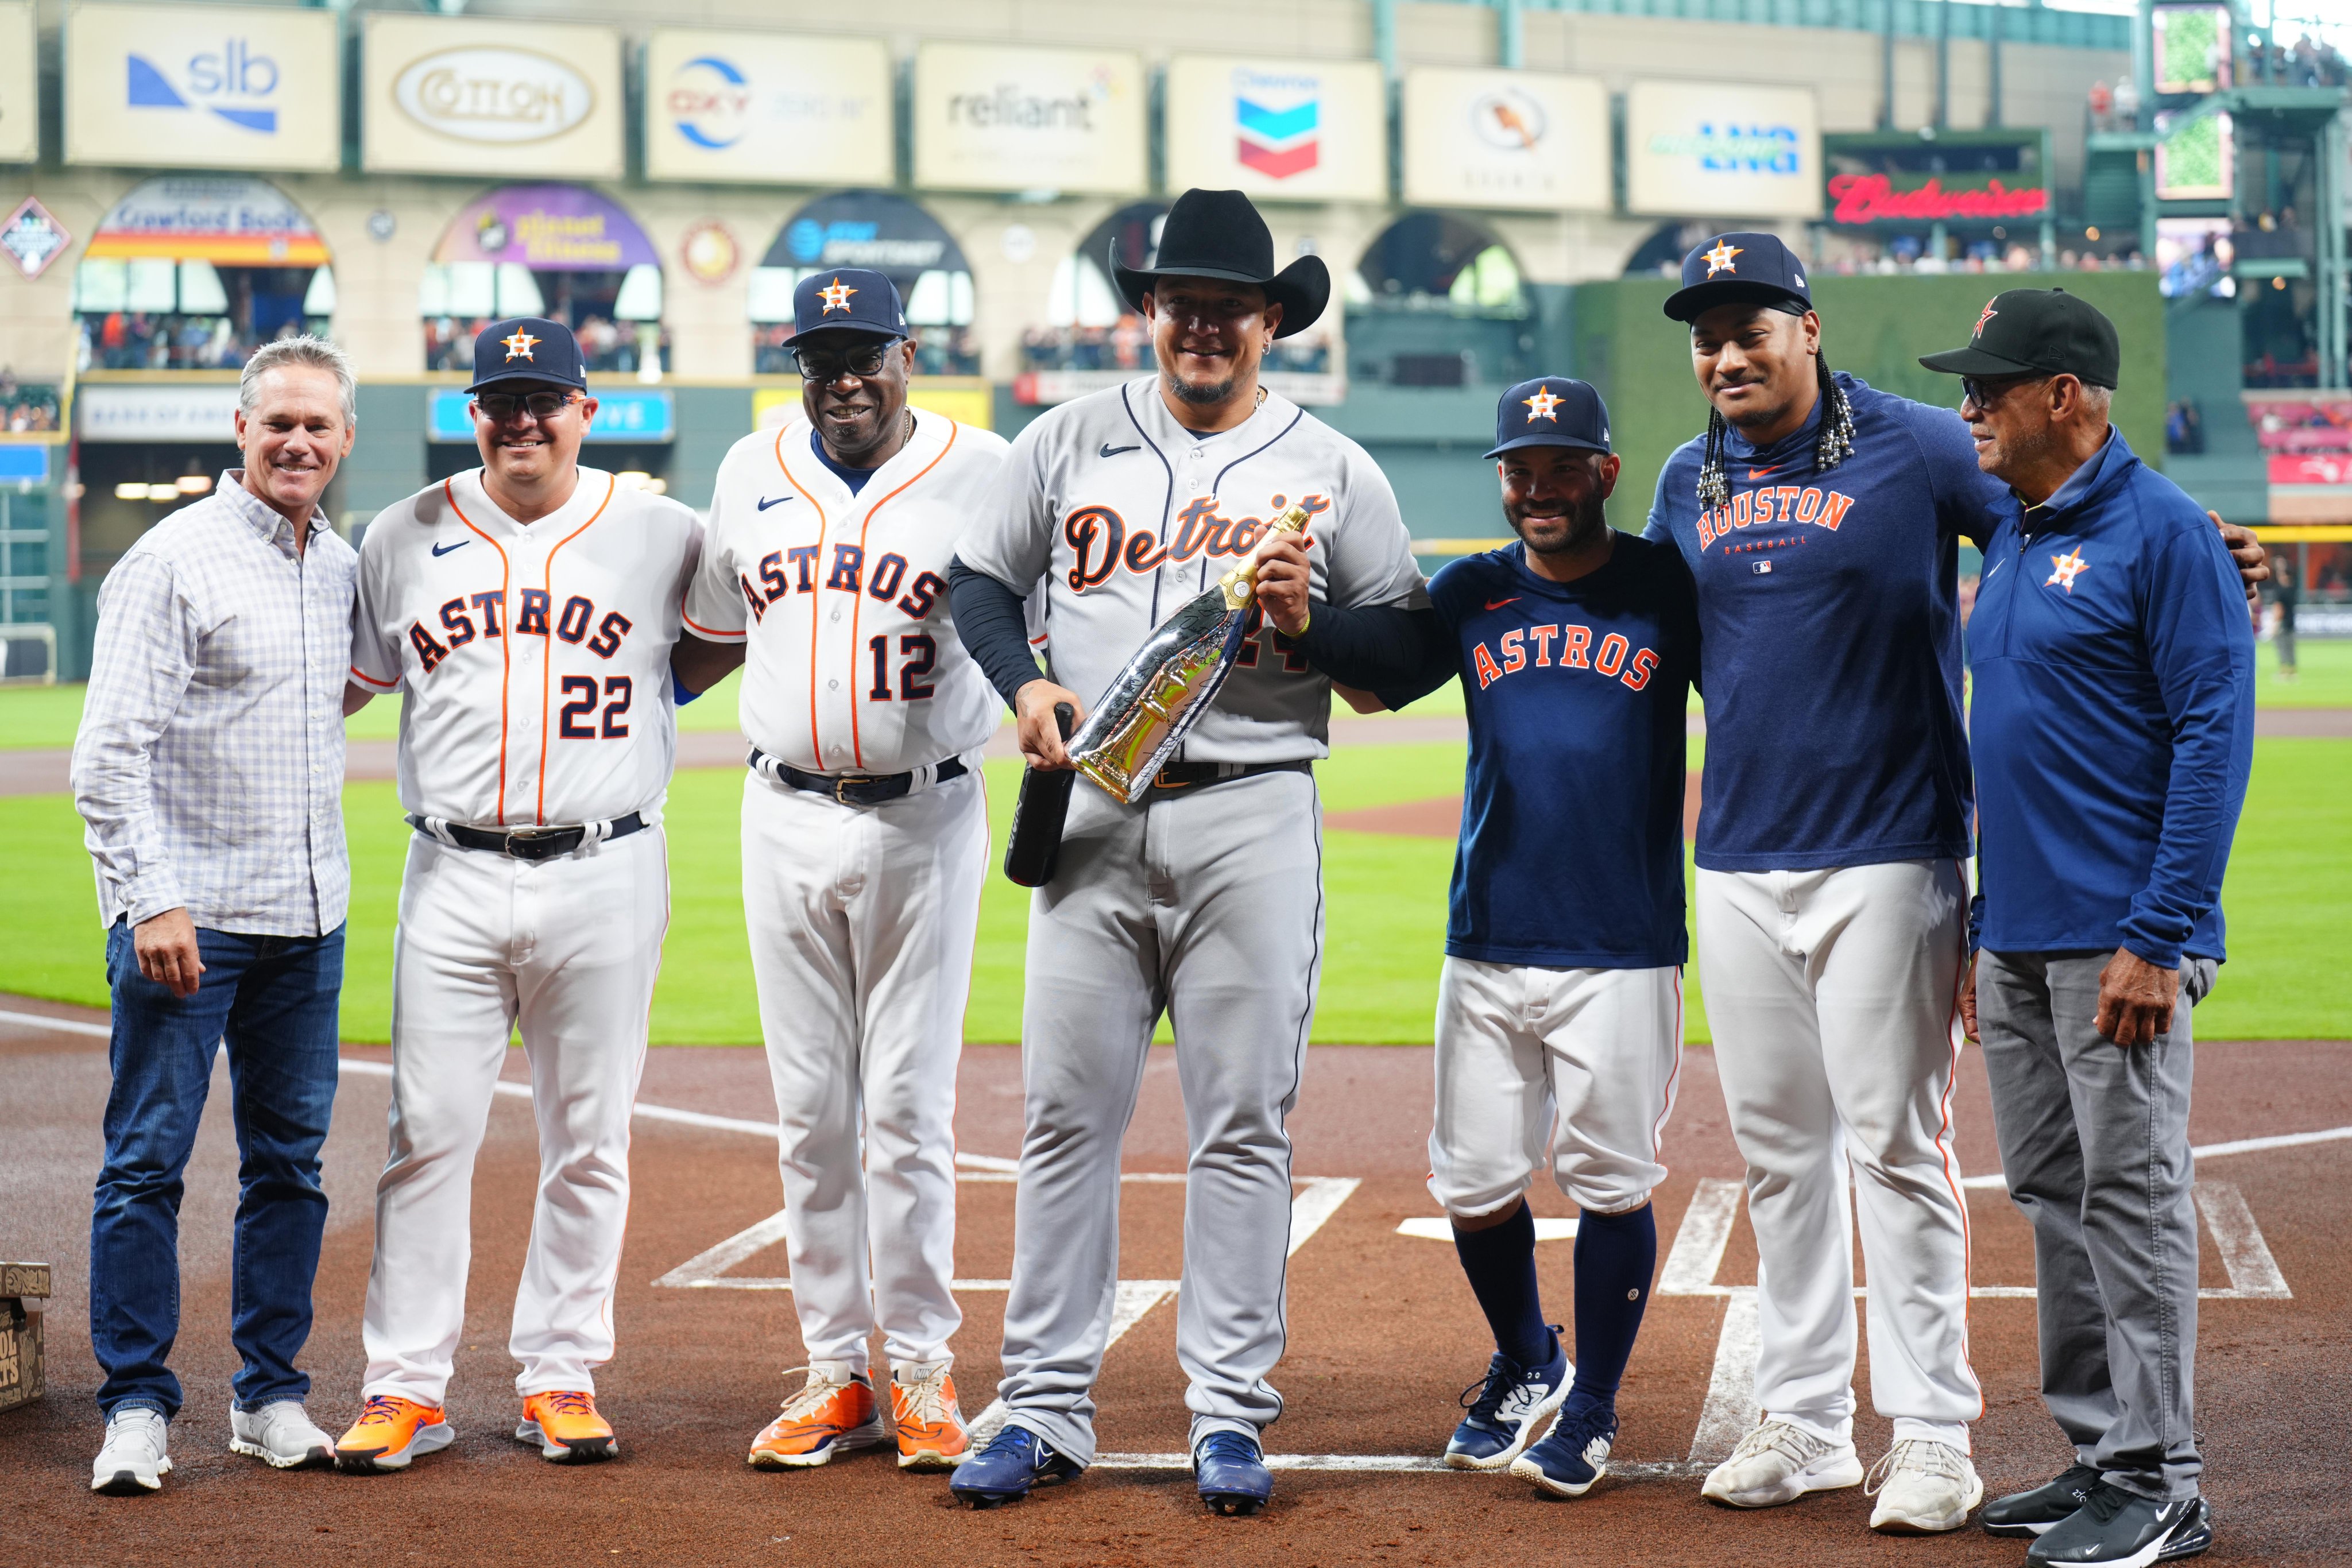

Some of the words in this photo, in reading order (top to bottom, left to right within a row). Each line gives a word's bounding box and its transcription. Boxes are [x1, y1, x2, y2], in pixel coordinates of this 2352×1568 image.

[189, 38, 278, 96] slb
[948, 84, 1093, 131] reliant
[1696, 486, 1855, 552] HOUSTON
[1724, 535, 1806, 555] BASEBALL
[741, 543, 948, 626] ASTROS
[409, 587, 633, 673] ASTROS
[1473, 624, 1661, 691] ASTROS
[869, 634, 937, 702] 12
[559, 675, 632, 740] 22
[914, 1368, 935, 1380] NIK
